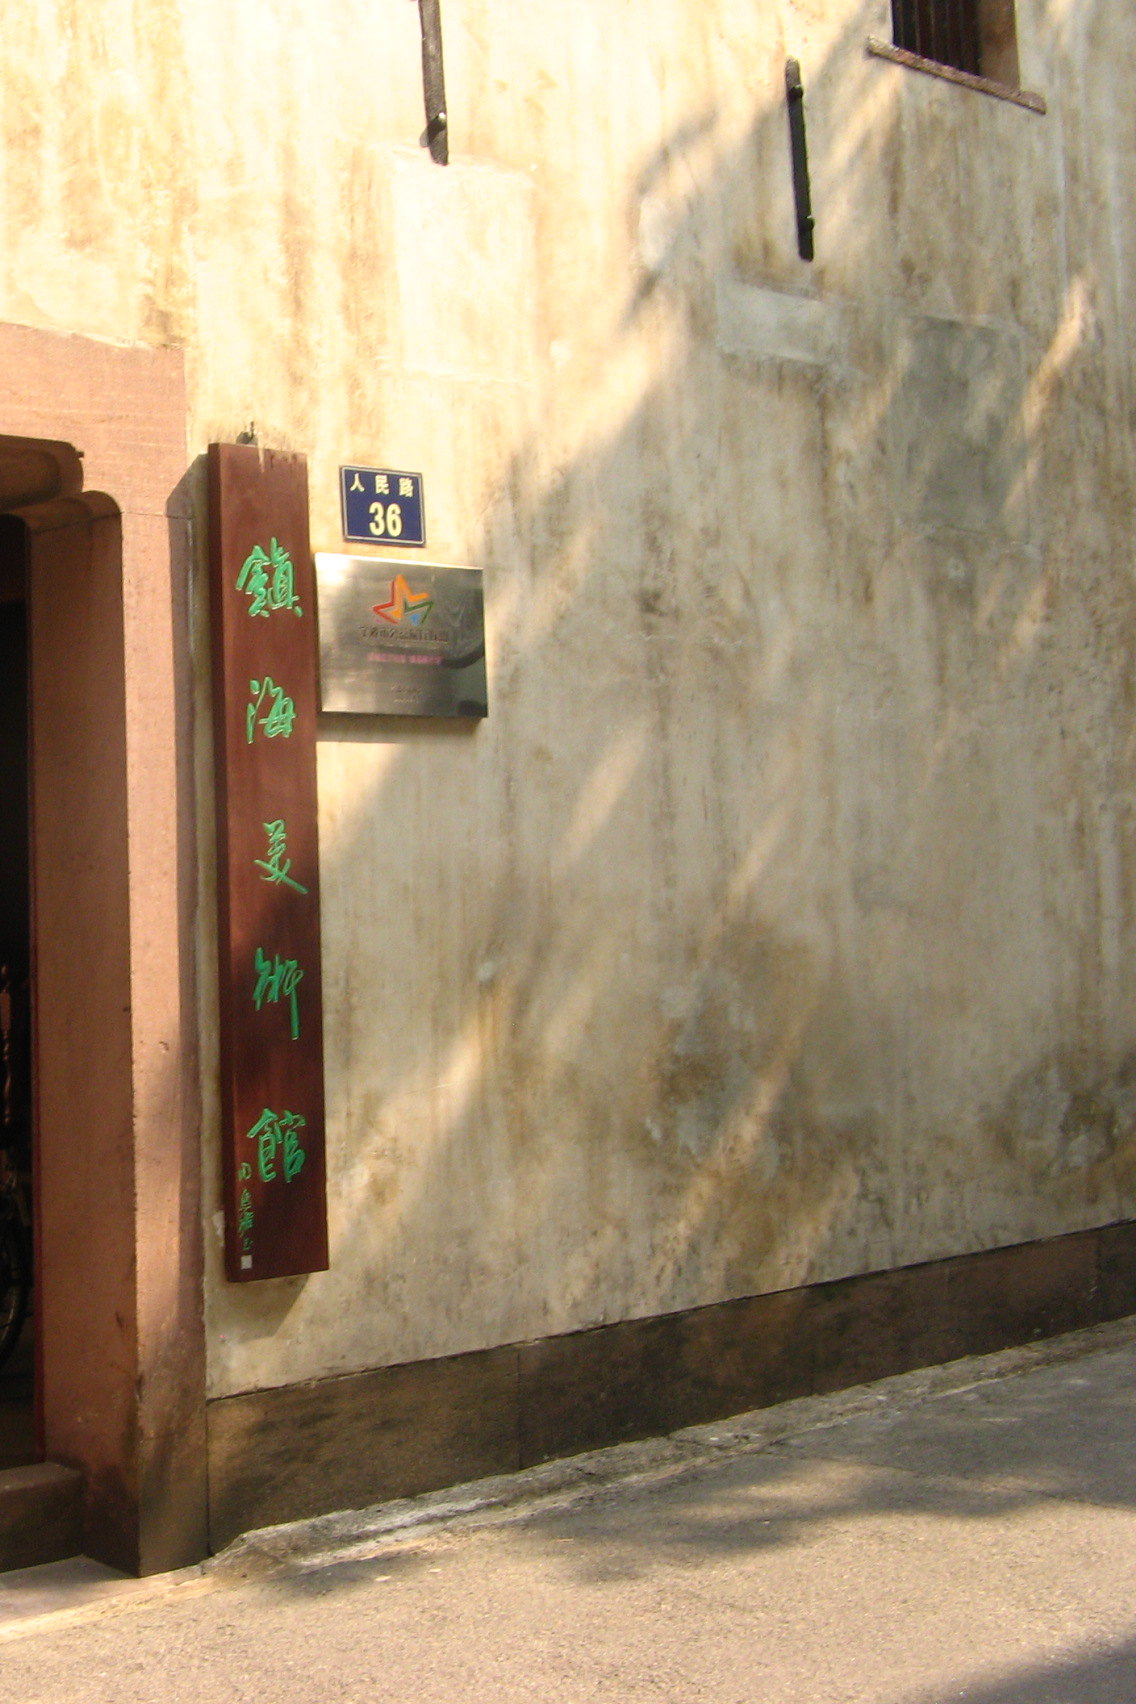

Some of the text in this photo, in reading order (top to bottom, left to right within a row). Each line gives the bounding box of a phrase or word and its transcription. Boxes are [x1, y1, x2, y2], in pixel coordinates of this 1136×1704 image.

[349, 472, 415, 498] 人民路
[368, 502, 402, 537] 36
